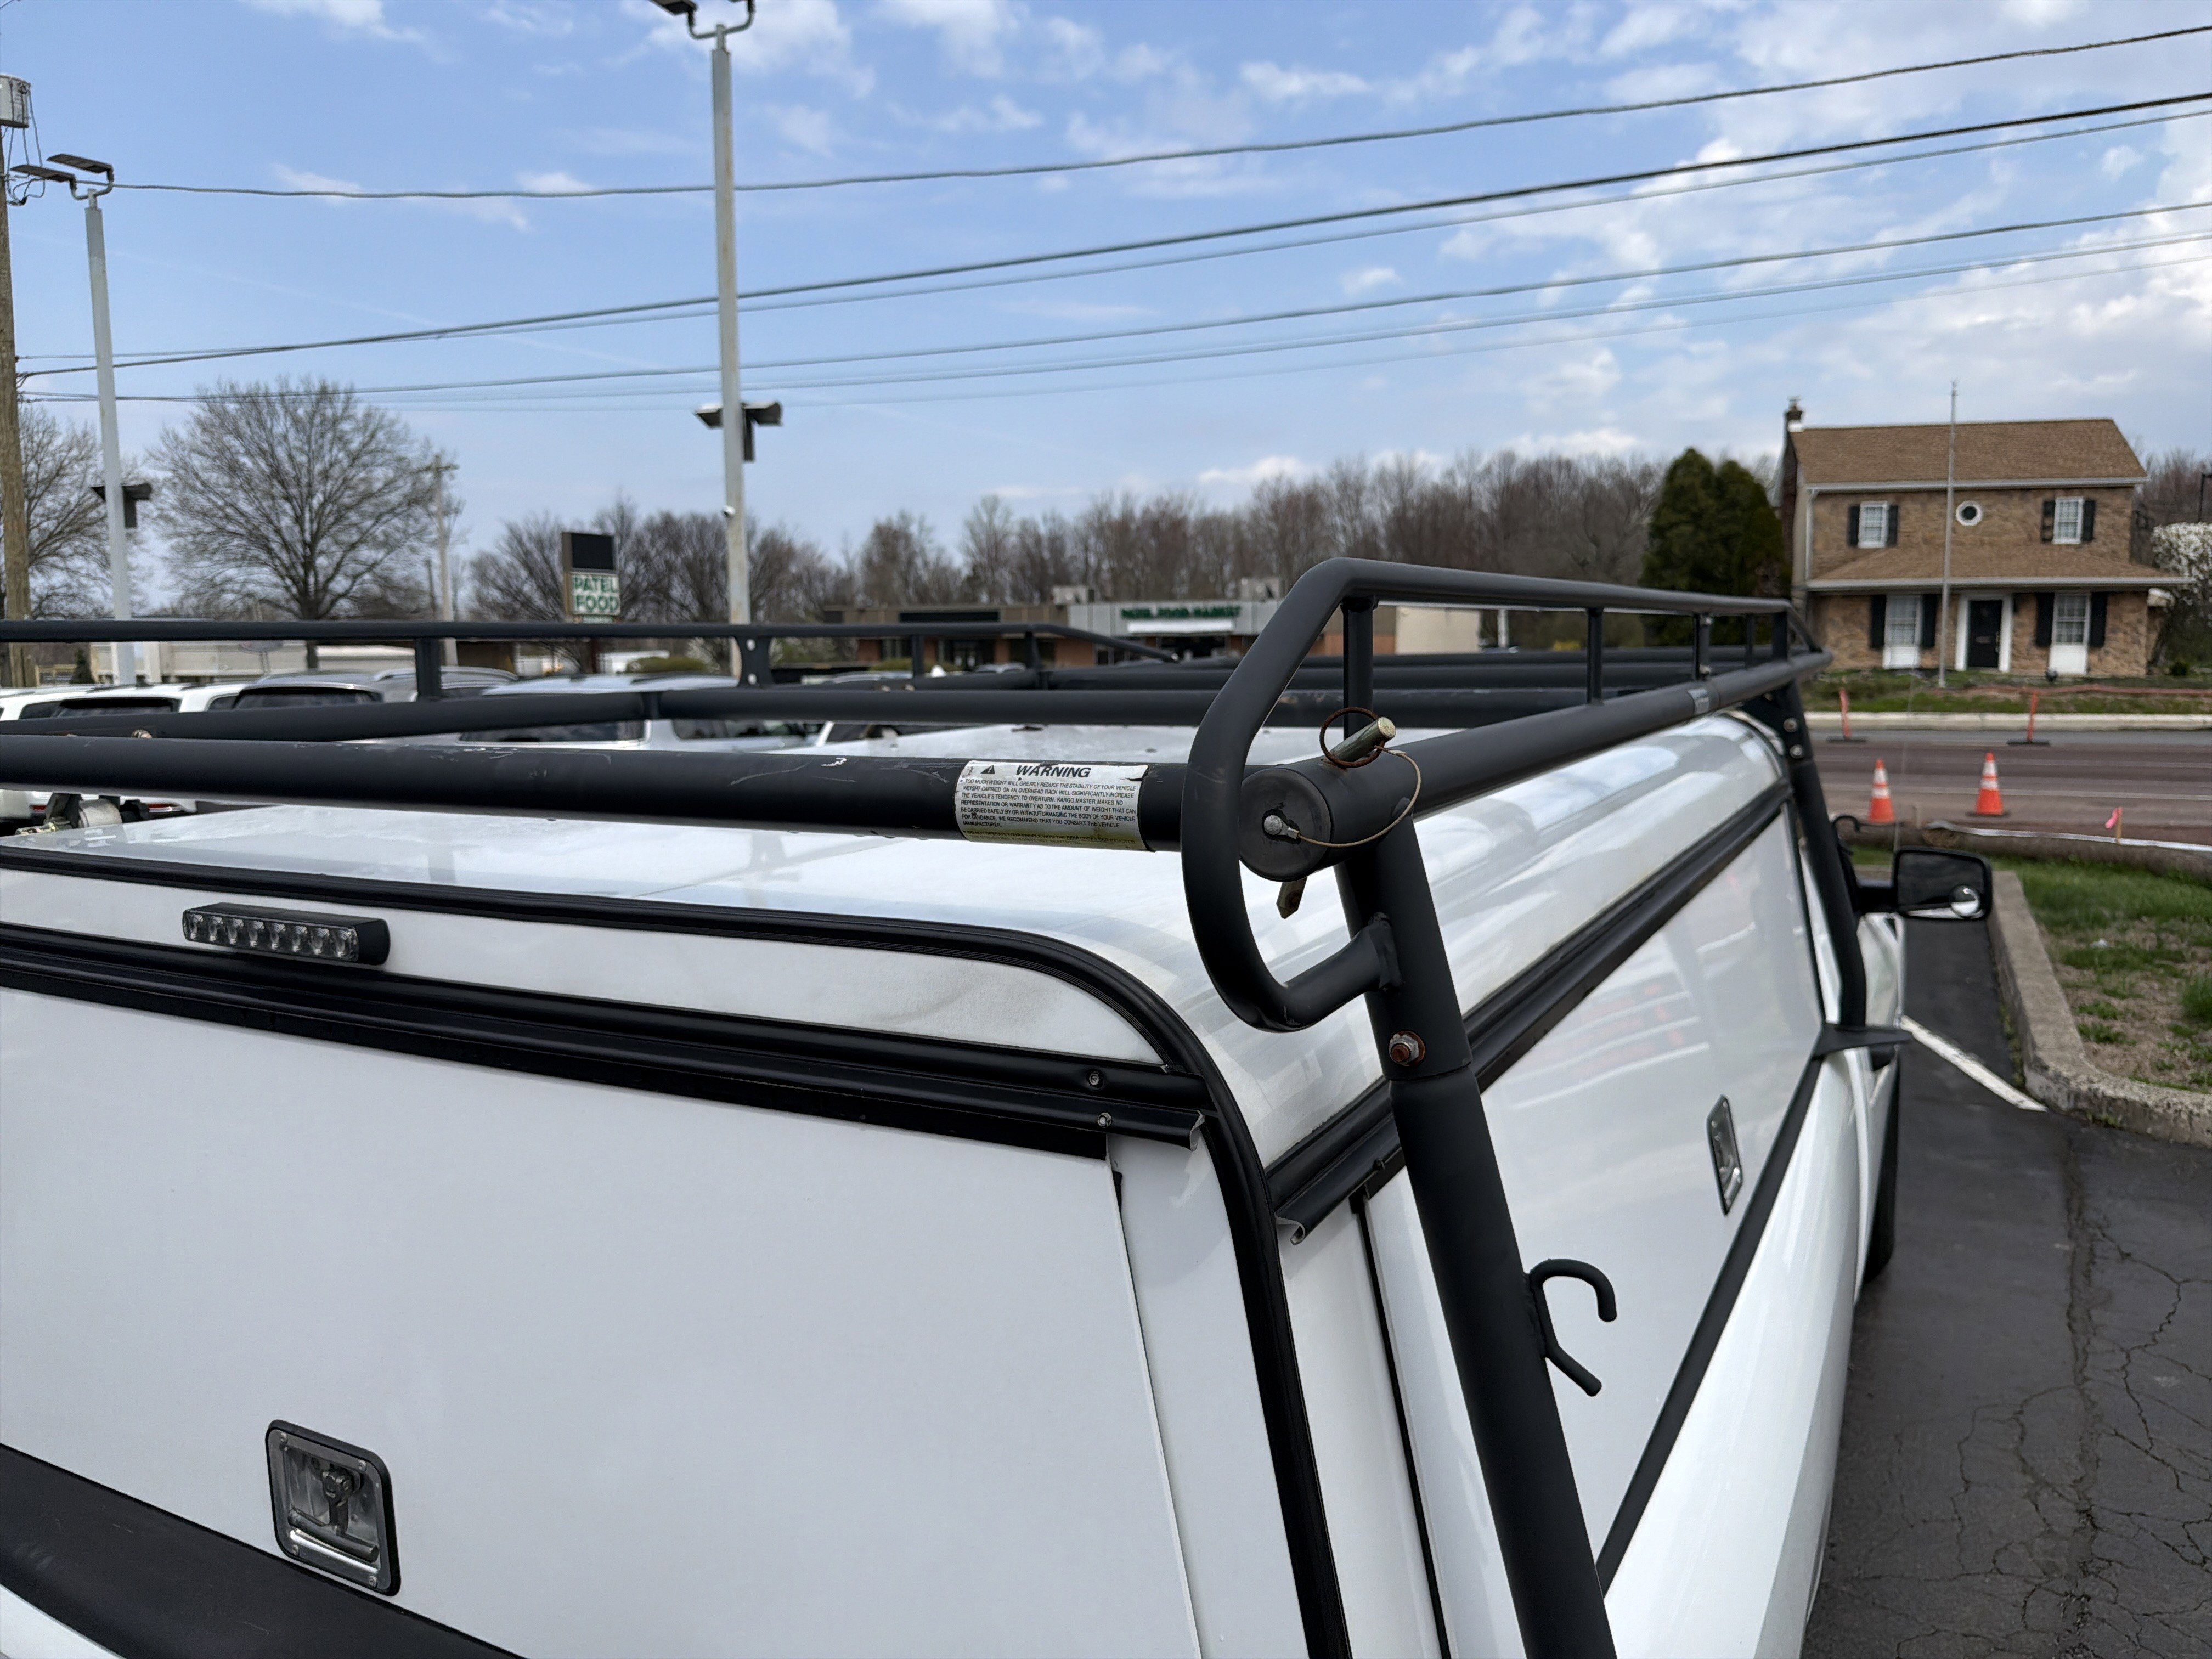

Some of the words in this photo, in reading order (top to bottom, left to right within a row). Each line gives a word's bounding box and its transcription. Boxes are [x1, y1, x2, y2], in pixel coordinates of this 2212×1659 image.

[574, 577, 619, 592] PATEL
[575, 595, 618, 612] FOOD
[1016, 765, 1091, 778] WARNING
